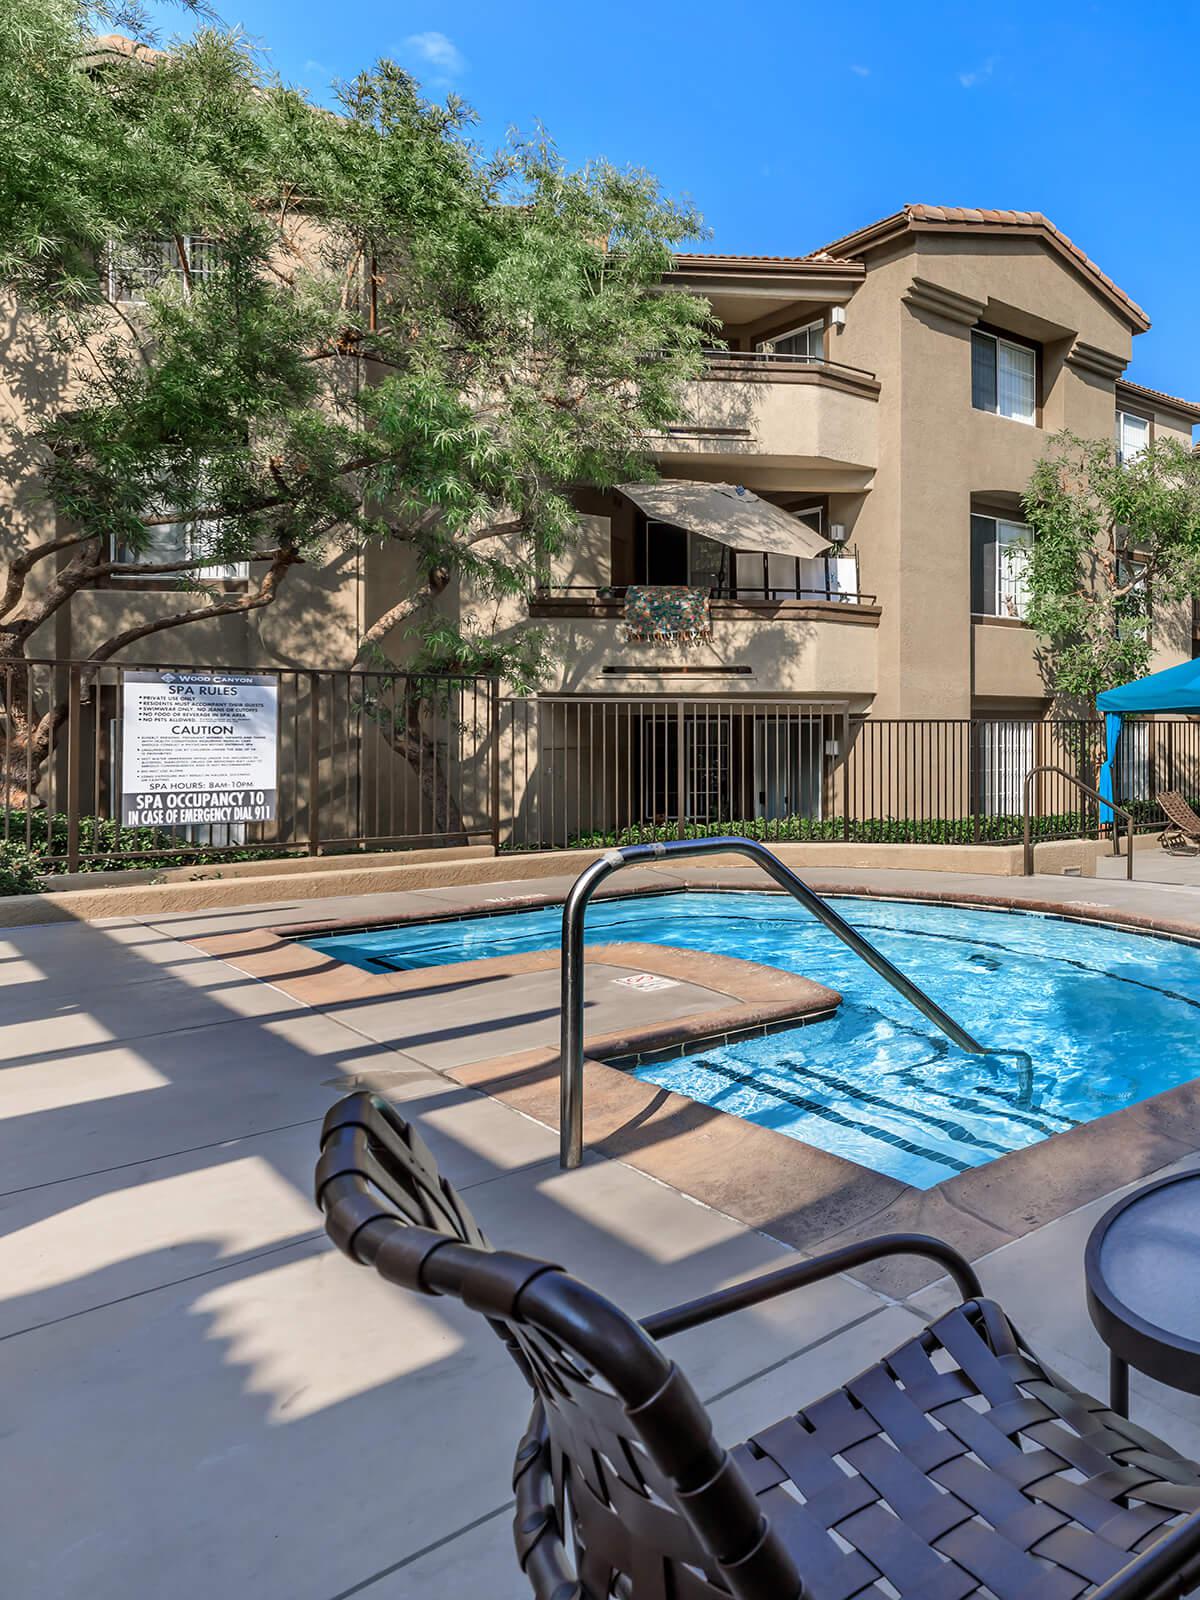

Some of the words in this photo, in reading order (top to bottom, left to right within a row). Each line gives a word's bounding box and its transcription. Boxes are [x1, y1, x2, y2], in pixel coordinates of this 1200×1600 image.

[168, 685, 194, 695] SPA
[199, 686, 238, 696] RULES
[171, 725, 234, 735] CAUTION
[136, 794, 163, 810] SPA
[166, 792, 245, 808] OCCUPANCY
[250, 791, 264, 805] 10
[128, 810, 139, 825] IN
[141, 810, 164, 824] CASE
[166, 809, 178, 824] OF
[180, 807, 232, 822] EMERGENCY
[234, 806, 252, 820] DIAL
[255, 805, 270, 819] 911
